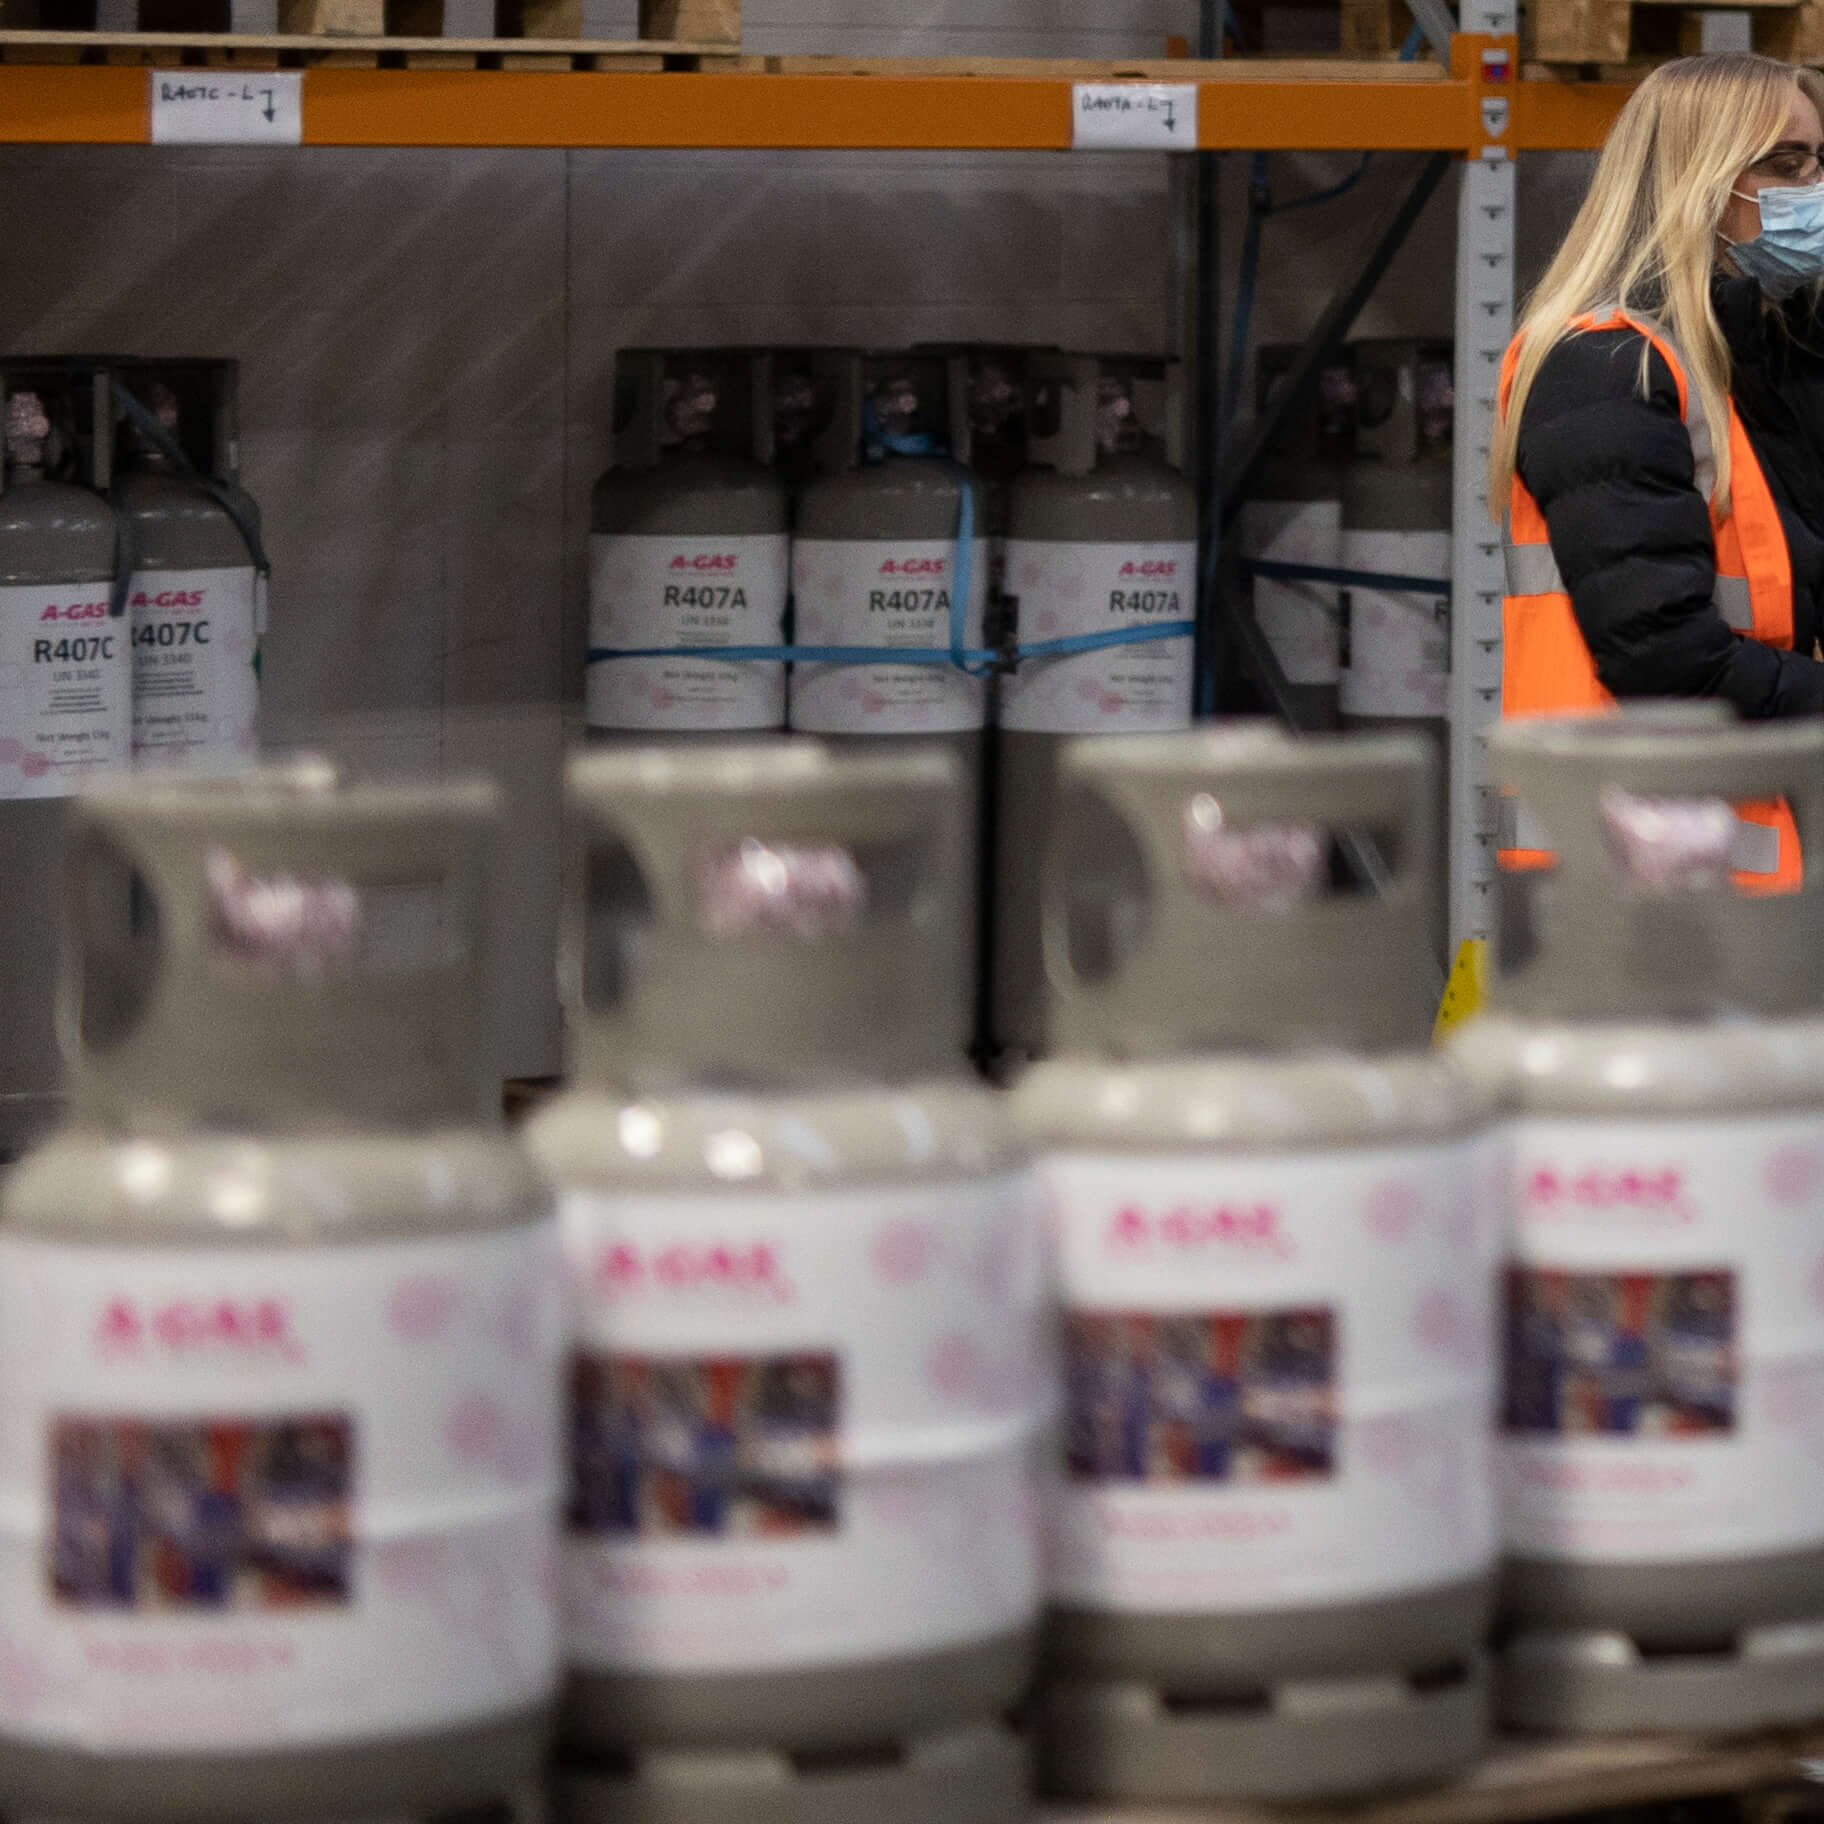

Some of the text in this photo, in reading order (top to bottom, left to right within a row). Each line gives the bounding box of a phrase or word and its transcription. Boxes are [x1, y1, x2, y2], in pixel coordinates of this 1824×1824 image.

[669, 554, 739, 569] A-GAS
[879, 558, 946, 573] A-GAS
[1119, 560, 1177, 576] A-GAS
[130, 590, 206, 607] A-GAS
[664, 585, 747, 609] R407A
[869, 590, 951, 612] R407A
[1110, 590, 1180, 613] R407A
[40, 603, 108, 621] A-GAS
[35, 636, 115, 663] R407C
